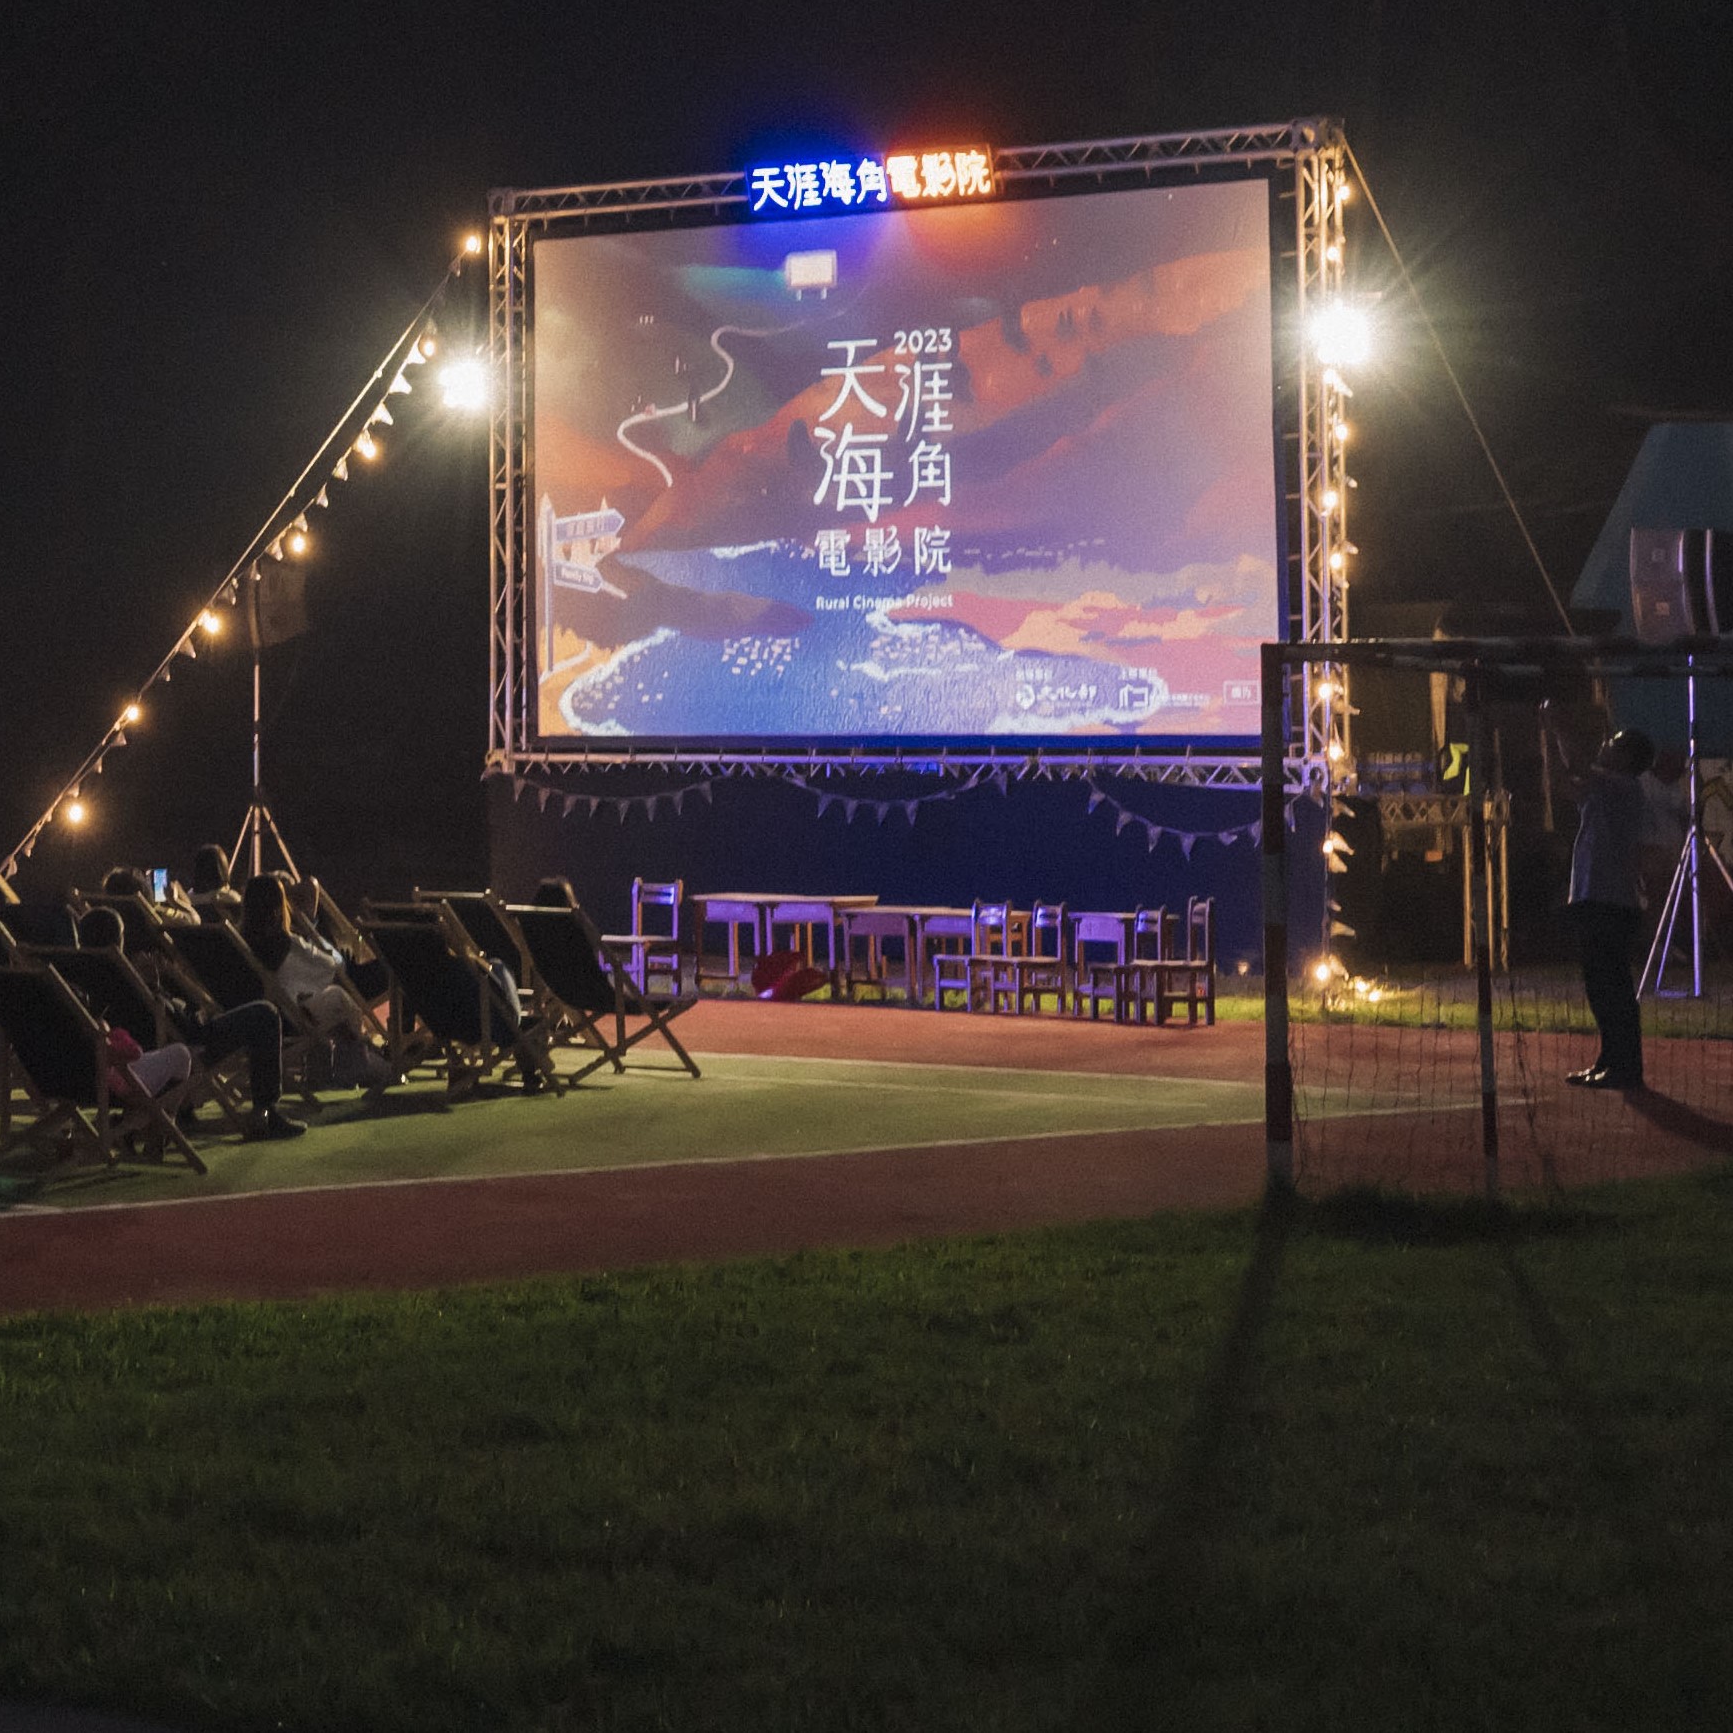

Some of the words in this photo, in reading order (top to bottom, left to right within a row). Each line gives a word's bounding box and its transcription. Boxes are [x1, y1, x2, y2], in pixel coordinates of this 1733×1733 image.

[751, 152, 991, 211] 天涯海角電影院
[894, 328, 952, 355] 2023
[814, 525, 952, 577] 電影院
[815, 595, 850, 611] Rural
[906, 593, 953, 611] Project
